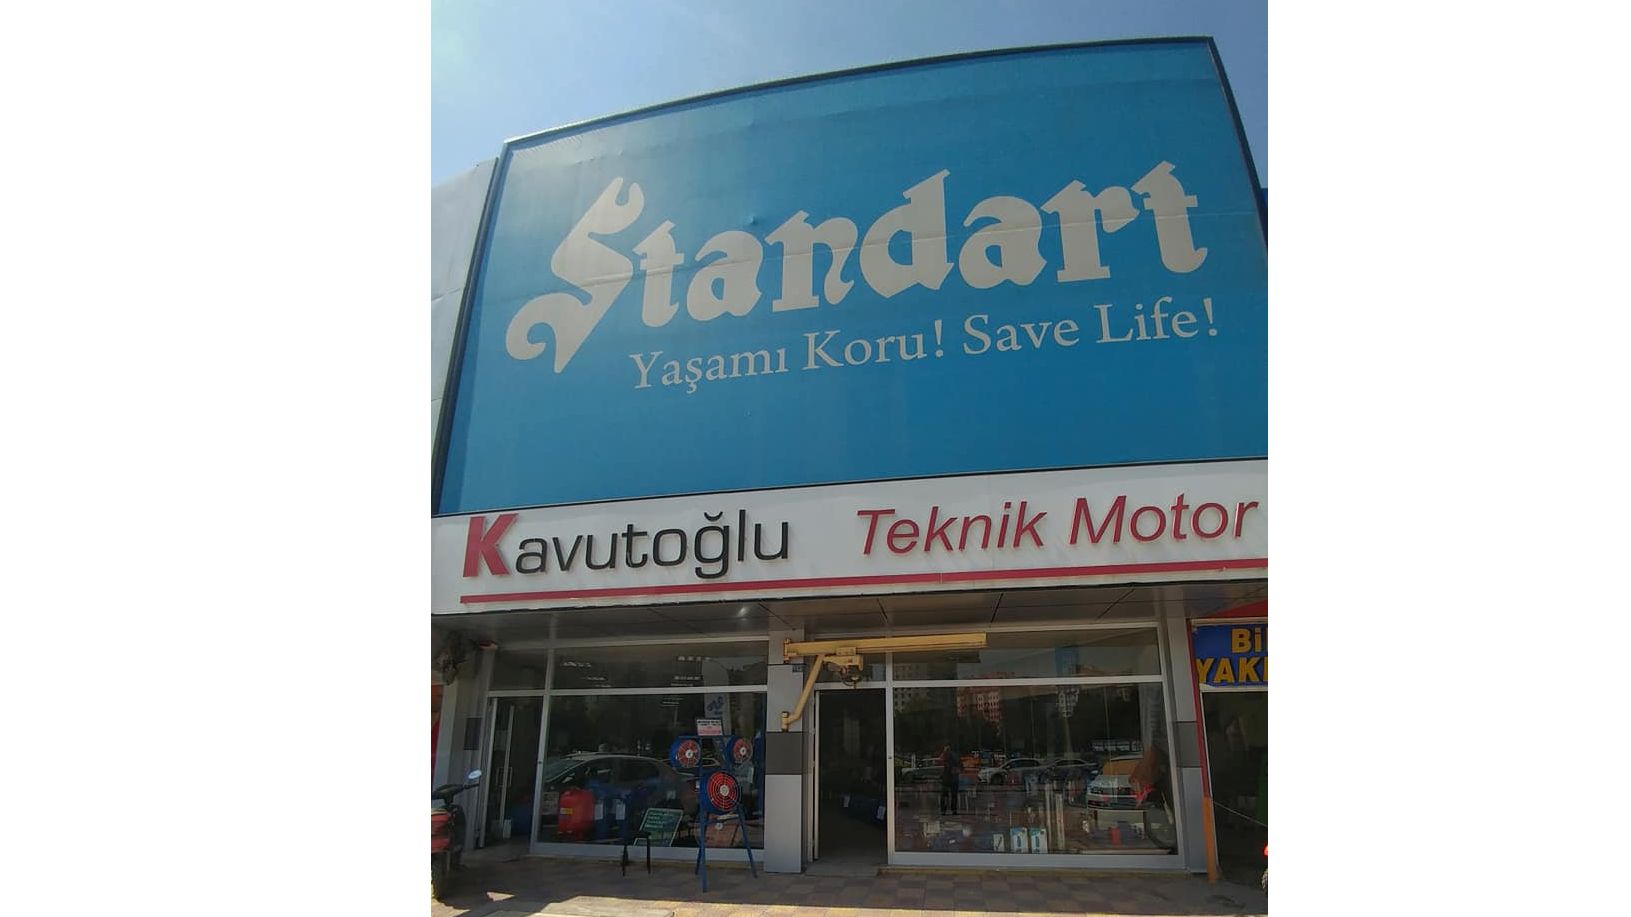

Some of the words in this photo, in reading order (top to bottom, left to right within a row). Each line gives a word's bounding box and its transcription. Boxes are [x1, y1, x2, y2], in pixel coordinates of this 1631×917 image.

[505, 161, 1207, 374] Standart
[629, 347, 789, 394] Yaşamı
[802, 320, 944, 370] Koru!
[963, 315, 1080, 354] Save
[1093, 296, 1217, 343] Life!
[463, 509, 789, 579] Kavutoğlu
[857, 501, 1048, 555] Teknik
[1070, 493, 1259, 545] Motor
[1232, 627, 1268, 653] Bi
